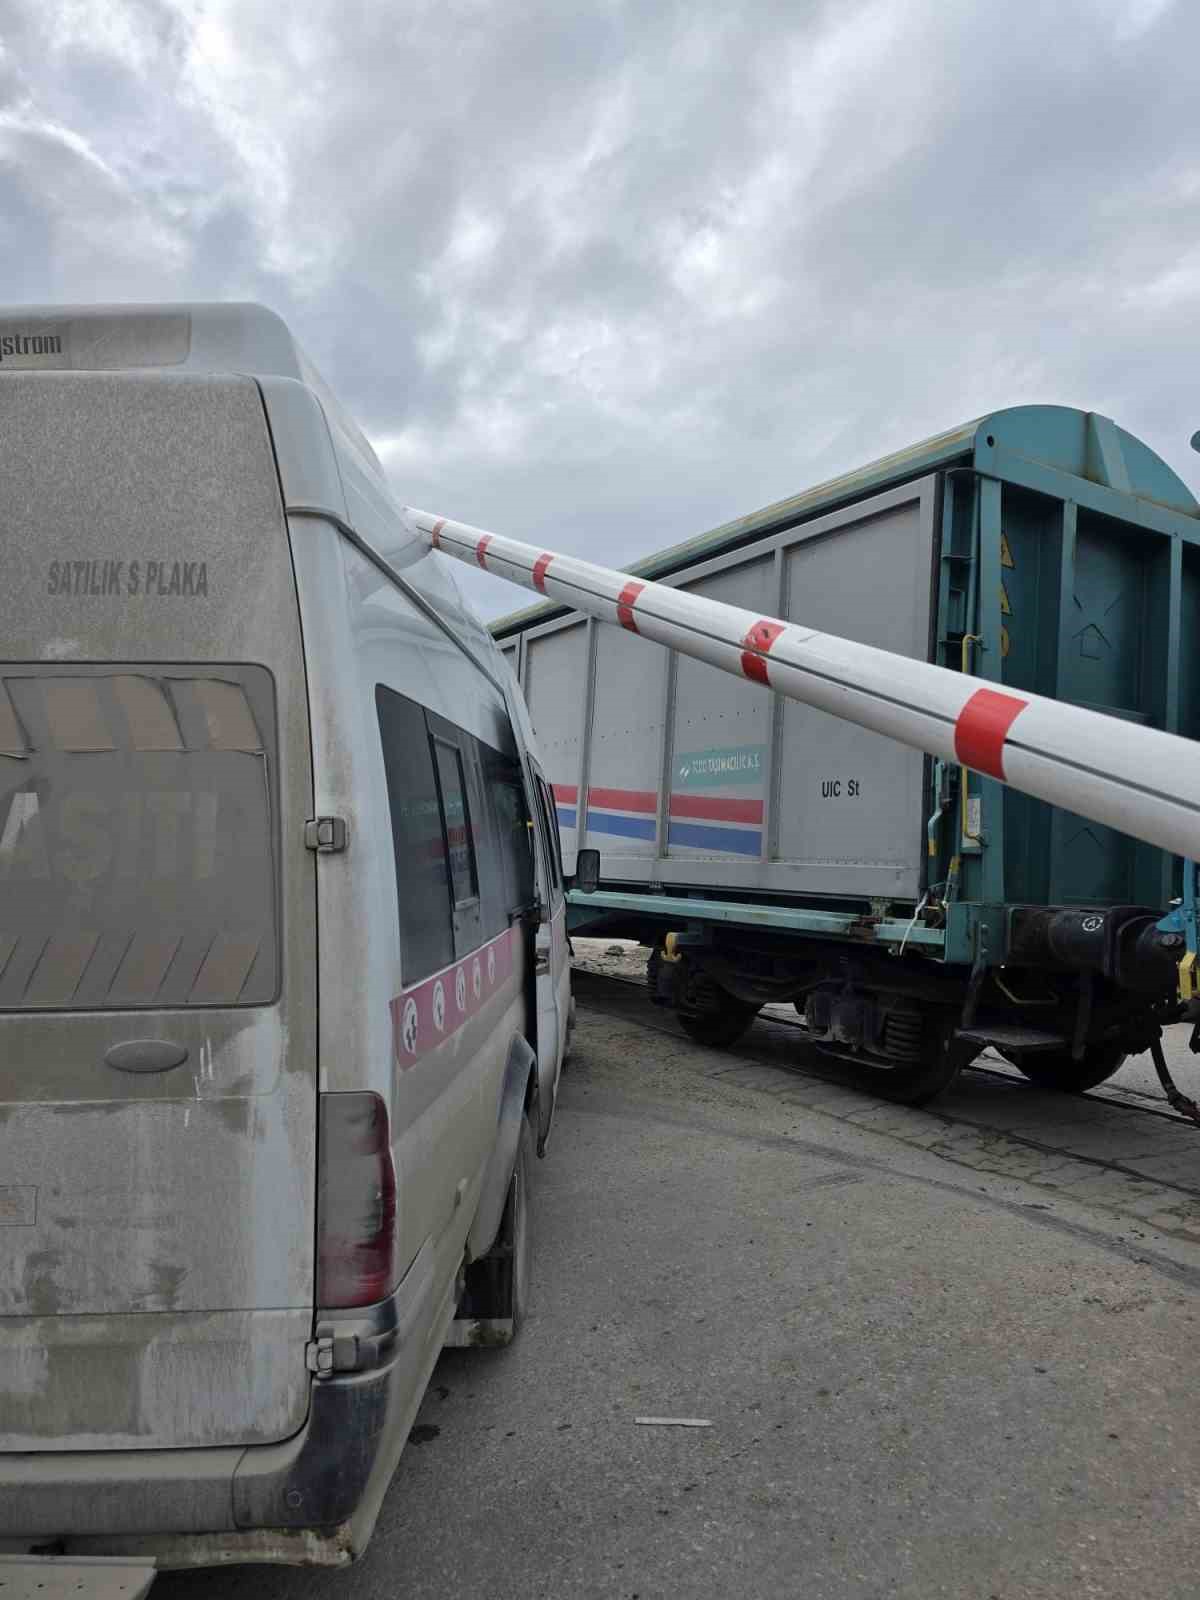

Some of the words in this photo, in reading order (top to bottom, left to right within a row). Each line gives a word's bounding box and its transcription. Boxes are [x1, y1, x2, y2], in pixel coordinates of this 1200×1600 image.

[126, 560, 140, 595] S
[145, 560, 209, 597] PLAKA
[822, 780, 841, 798] UIC
[848, 779, 860, 797] St
